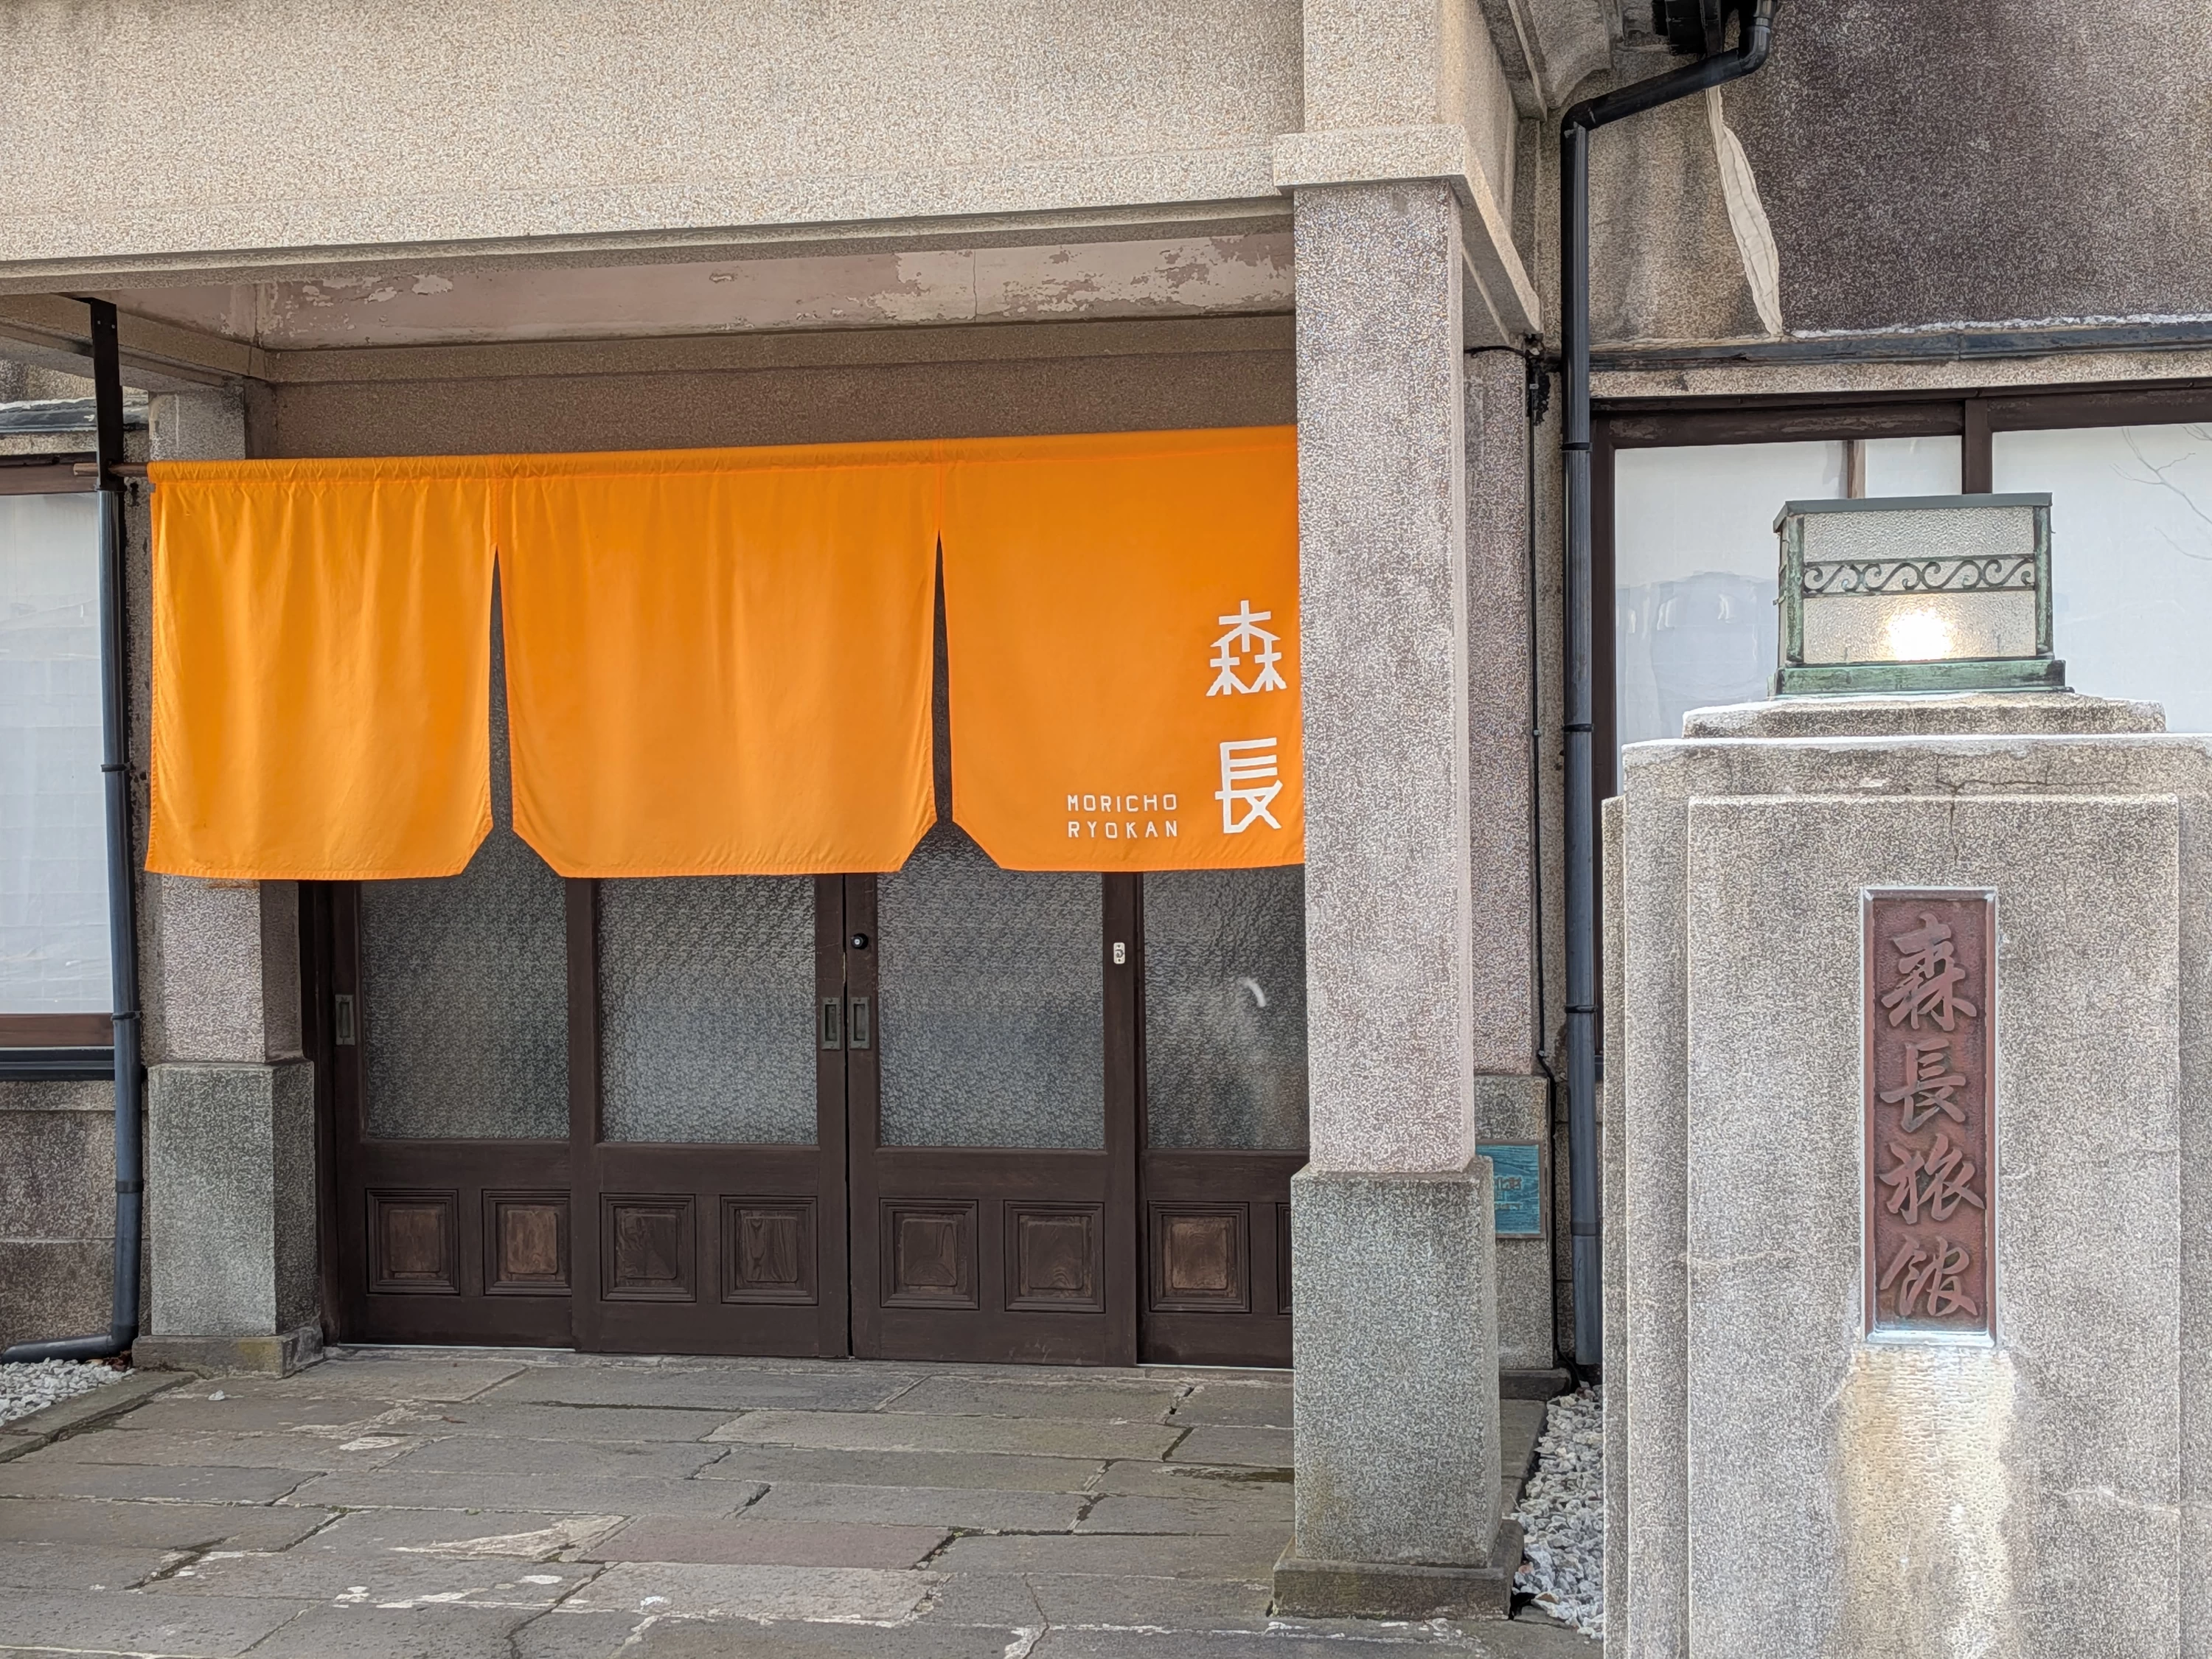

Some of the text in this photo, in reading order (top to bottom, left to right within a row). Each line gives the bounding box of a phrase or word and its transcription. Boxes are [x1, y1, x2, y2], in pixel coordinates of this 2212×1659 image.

[1206, 599, 1287, 834] 森長
[1068, 794, 1178, 813] MORICHO
[1068, 821, 1178, 838] RYOKAN
[1879, 912, 1986, 1317] 森長旅館
